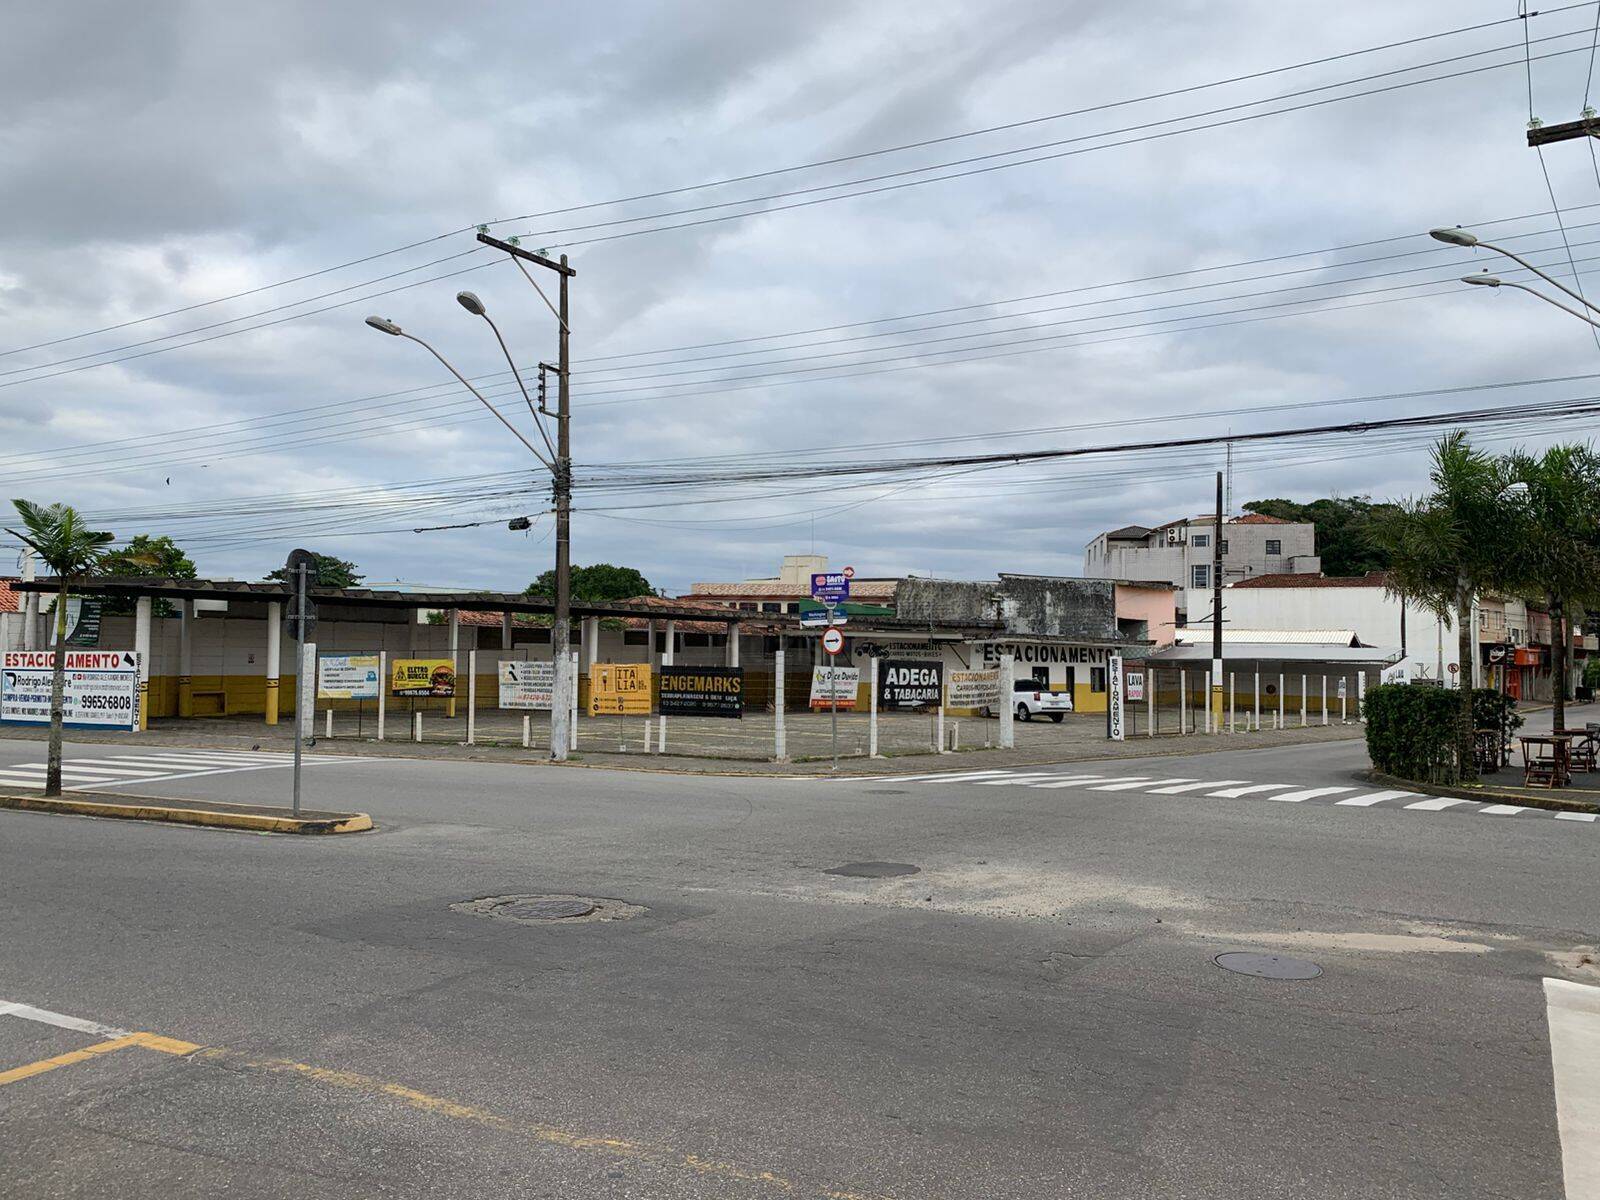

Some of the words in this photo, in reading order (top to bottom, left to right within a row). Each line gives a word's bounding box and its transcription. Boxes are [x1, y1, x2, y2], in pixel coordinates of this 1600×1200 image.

[5, 653, 120, 669] ESTACIOAMENTO
[983, 643, 1113, 663] ESTACIONAMENTO
[17, 675, 41, 688] Rodrigo
[661, 675, 741, 693] ENGEMARKS
[885, 667, 939, 686] ADEGA
[1128, 675, 1143, 686] LAVA
[884, 688, 891, 699] &
[894, 689, 939, 699] TABACARIA
[1111, 658, 1121, 737] ESTACIONAMENTO
